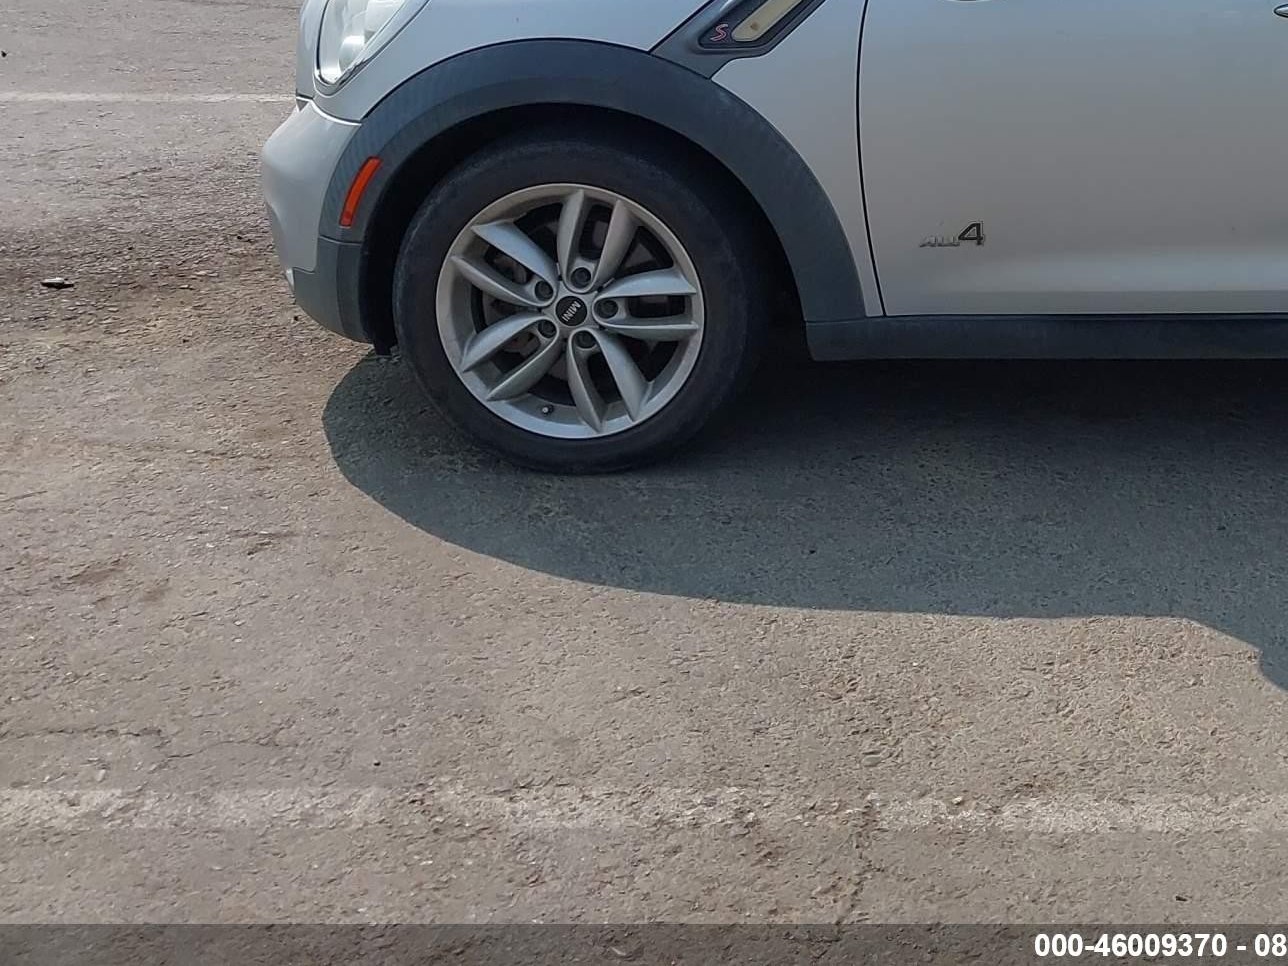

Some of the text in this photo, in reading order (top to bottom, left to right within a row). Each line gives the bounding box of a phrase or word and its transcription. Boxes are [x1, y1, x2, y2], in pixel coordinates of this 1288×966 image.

[709, 23, 729, 42] S
[958, 221, 984, 246] 4
[561, 300, 582, 322] MINI
